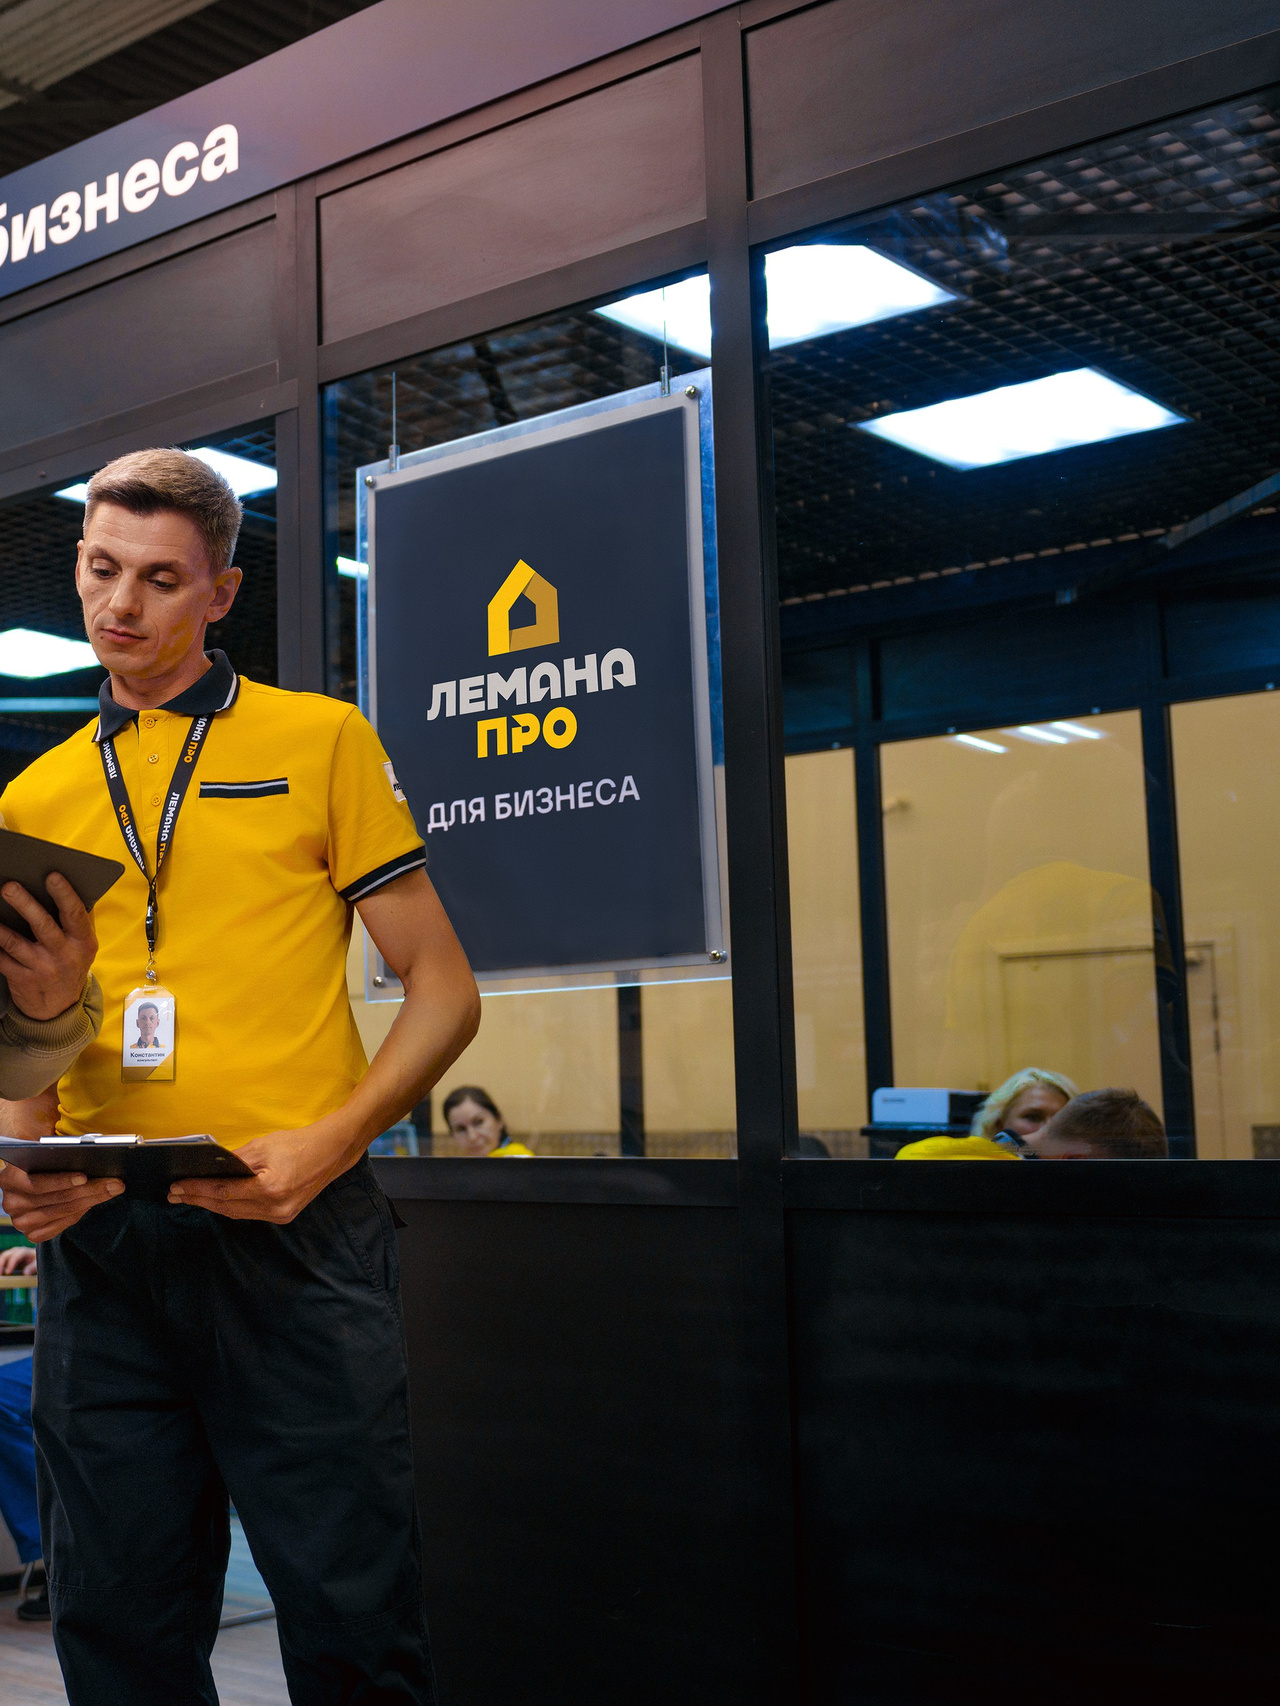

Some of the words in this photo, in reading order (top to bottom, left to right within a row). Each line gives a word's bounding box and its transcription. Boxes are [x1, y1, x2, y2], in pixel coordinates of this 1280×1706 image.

[426, 647, 637, 721] ЛЕМАНА
[183, 741, 198, 763] ПРО
[477, 706, 578, 759] ПРО
[119, 804, 131, 827] ПРО
[161, 791, 180, 841] ЛЕМАНА
[427, 797, 486, 834] ДЛЯ
[495, 775, 641, 820] БИЗНЕСА
